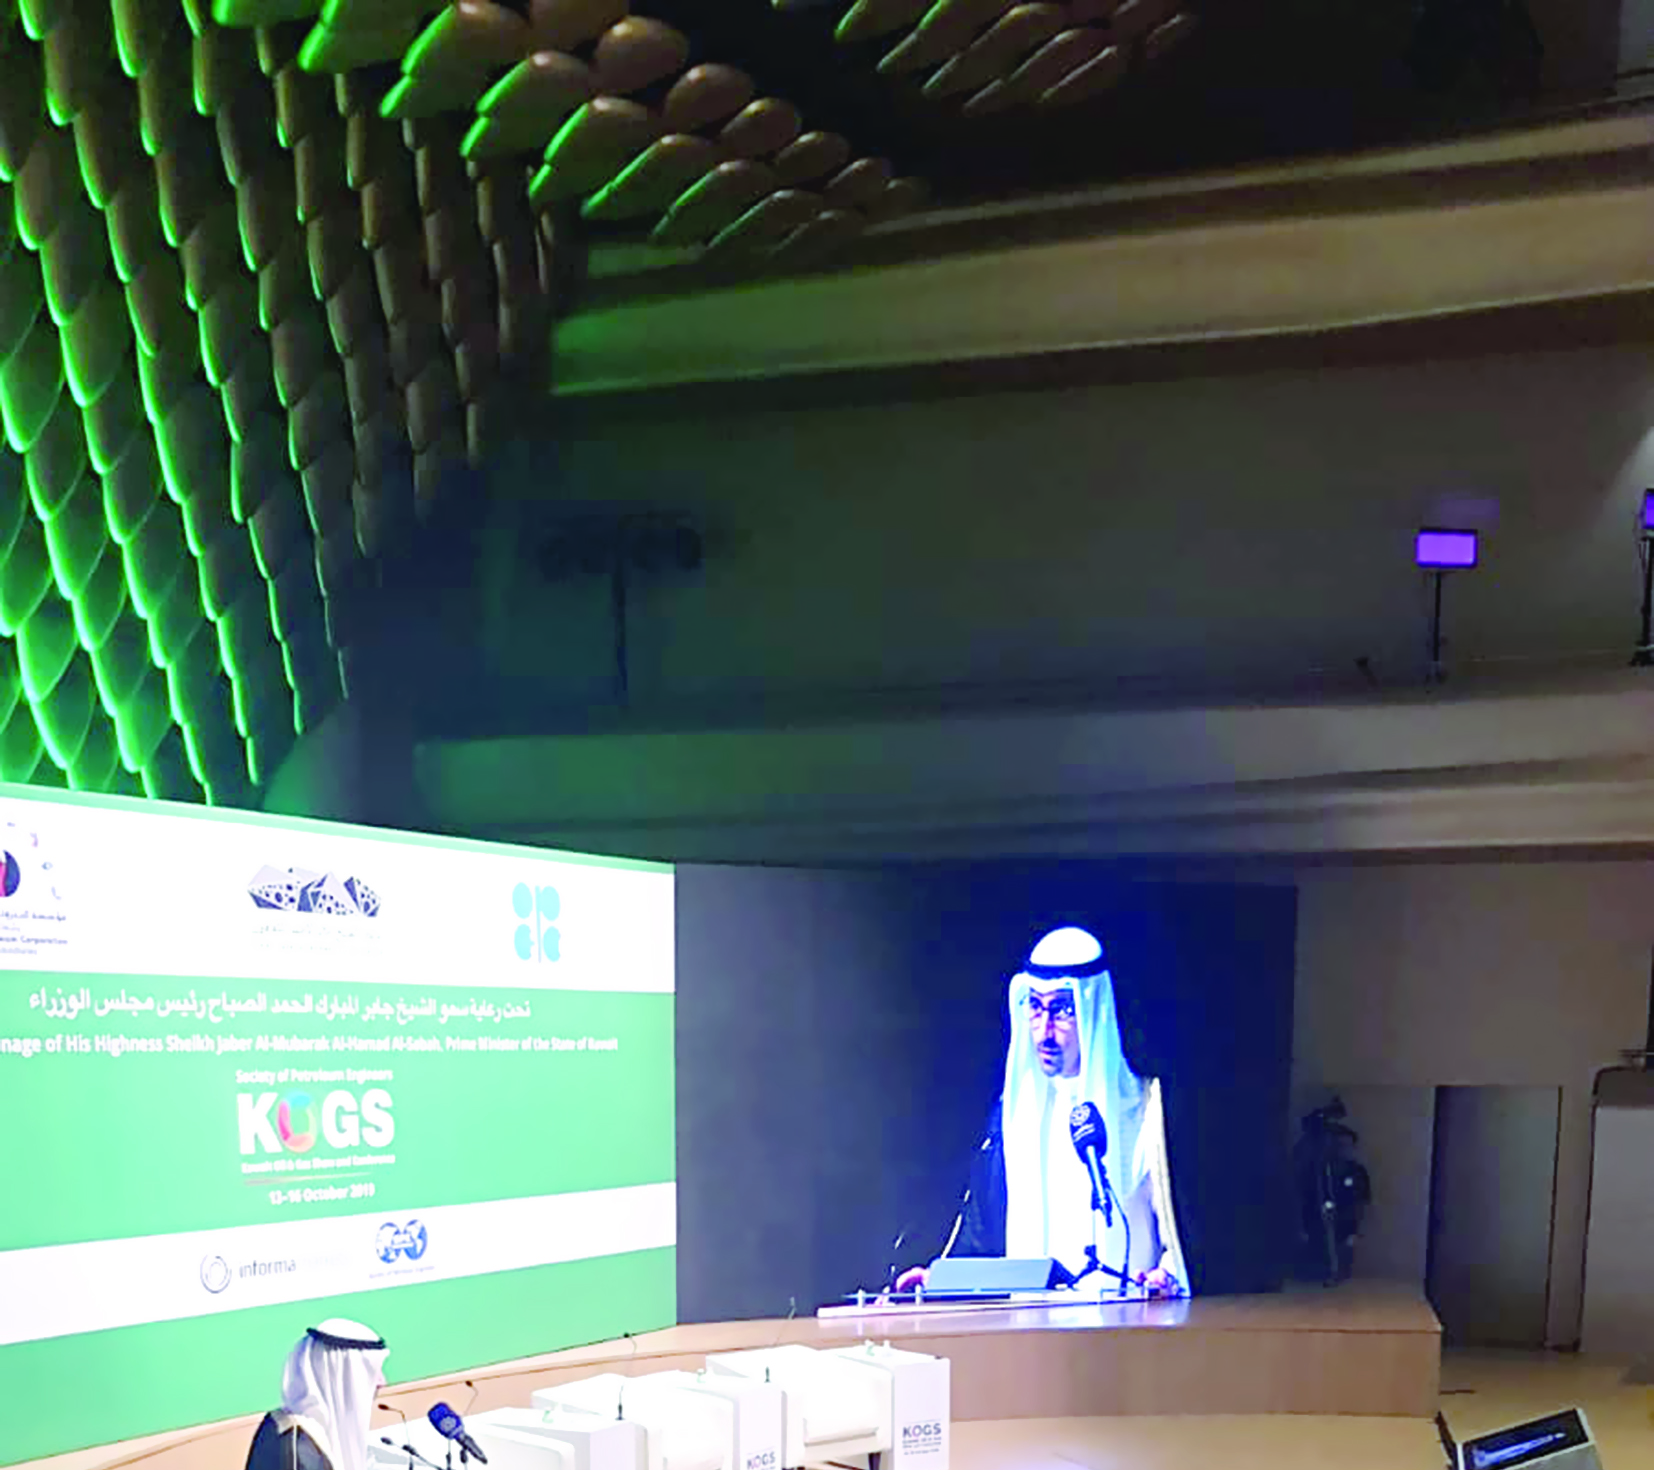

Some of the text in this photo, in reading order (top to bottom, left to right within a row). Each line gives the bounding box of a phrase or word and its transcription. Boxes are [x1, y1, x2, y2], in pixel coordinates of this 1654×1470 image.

[29, 986, 91, 1019] الوزراء
[95, 988, 155, 1017] مجلس
[157, 989, 207, 1018] رئيس
[207, 990, 267, 1023] الصباح
[271, 993, 313, 1014] الحمد
[396, 997, 437, 1025] الشيخ
[45, 1034, 62, 1052] of
[65, 1034, 91, 1052] His
[95, 1033, 163, 1057] Highness
[166, 1033, 214, 1052] Sheikh
[216, 1033, 253, 1055] Jaber
[521, 1036, 533, 1051] of
[577, 1036, 588, 1051] of
[235, 1067, 394, 1086] Society of Petroleum Engineers
[236, 1087, 395, 1155] KOGS
[303, 1185, 349, 1202] October
[239, 1259, 297, 1278] informa
[903, 1422, 942, 1438] KOGS
[746, 1450, 776, 1470] KOGS
